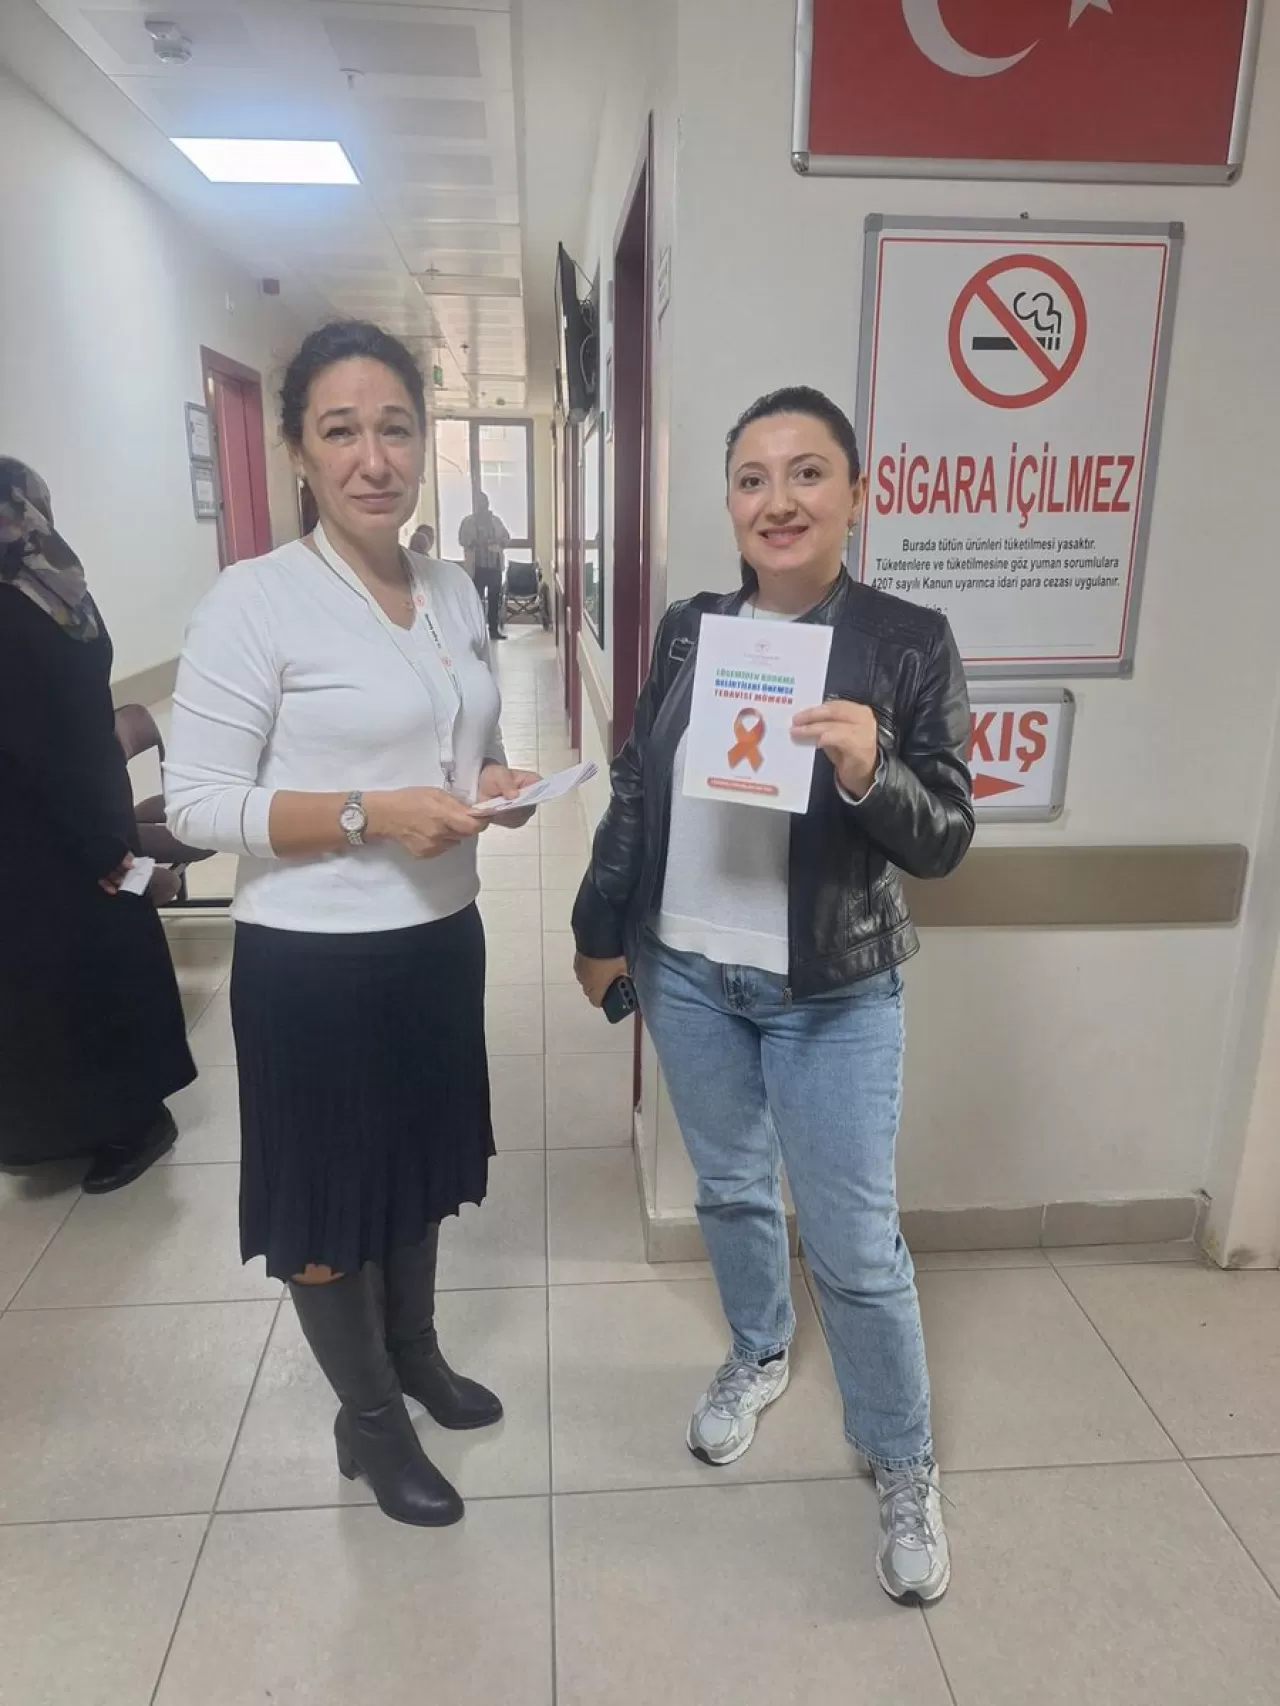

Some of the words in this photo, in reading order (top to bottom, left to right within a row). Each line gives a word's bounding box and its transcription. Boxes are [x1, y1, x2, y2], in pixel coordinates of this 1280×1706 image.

[875, 442, 998, 515] SİGARA
[1006, 442, 1136, 528] İÇİLMEZ
[902, 538, 936, 551] Burada
[938, 538, 963, 551] tütün
[965, 537, 1002, 551] ürünleri
[1004, 537, 1055, 550] tüketilmesi
[1057, 537, 1096, 553] yasaktır.
[876, 558, 931, 570] Tüketenlere
[933, 561, 944, 570] ve
[946, 557, 1009, 570] tüketilmesine
[1010, 557, 1028, 572] göz
[1030, 559, 1061, 572] yuman
[1063, 556, 1119, 568] sorumlulara
[871, 578, 893, 589] 4207
[896, 577, 920, 592] sayılı
[922, 577, 953, 589] Kanun
[955, 578, 995, 592] uyarınca
[996, 576, 1018, 588] idari
[1020, 578, 1041, 591] para
[1043, 578, 1072, 588] cezası
[1074, 576, 1120, 591] uygulanır.
[967, 711, 1049, 773] KIŞ
